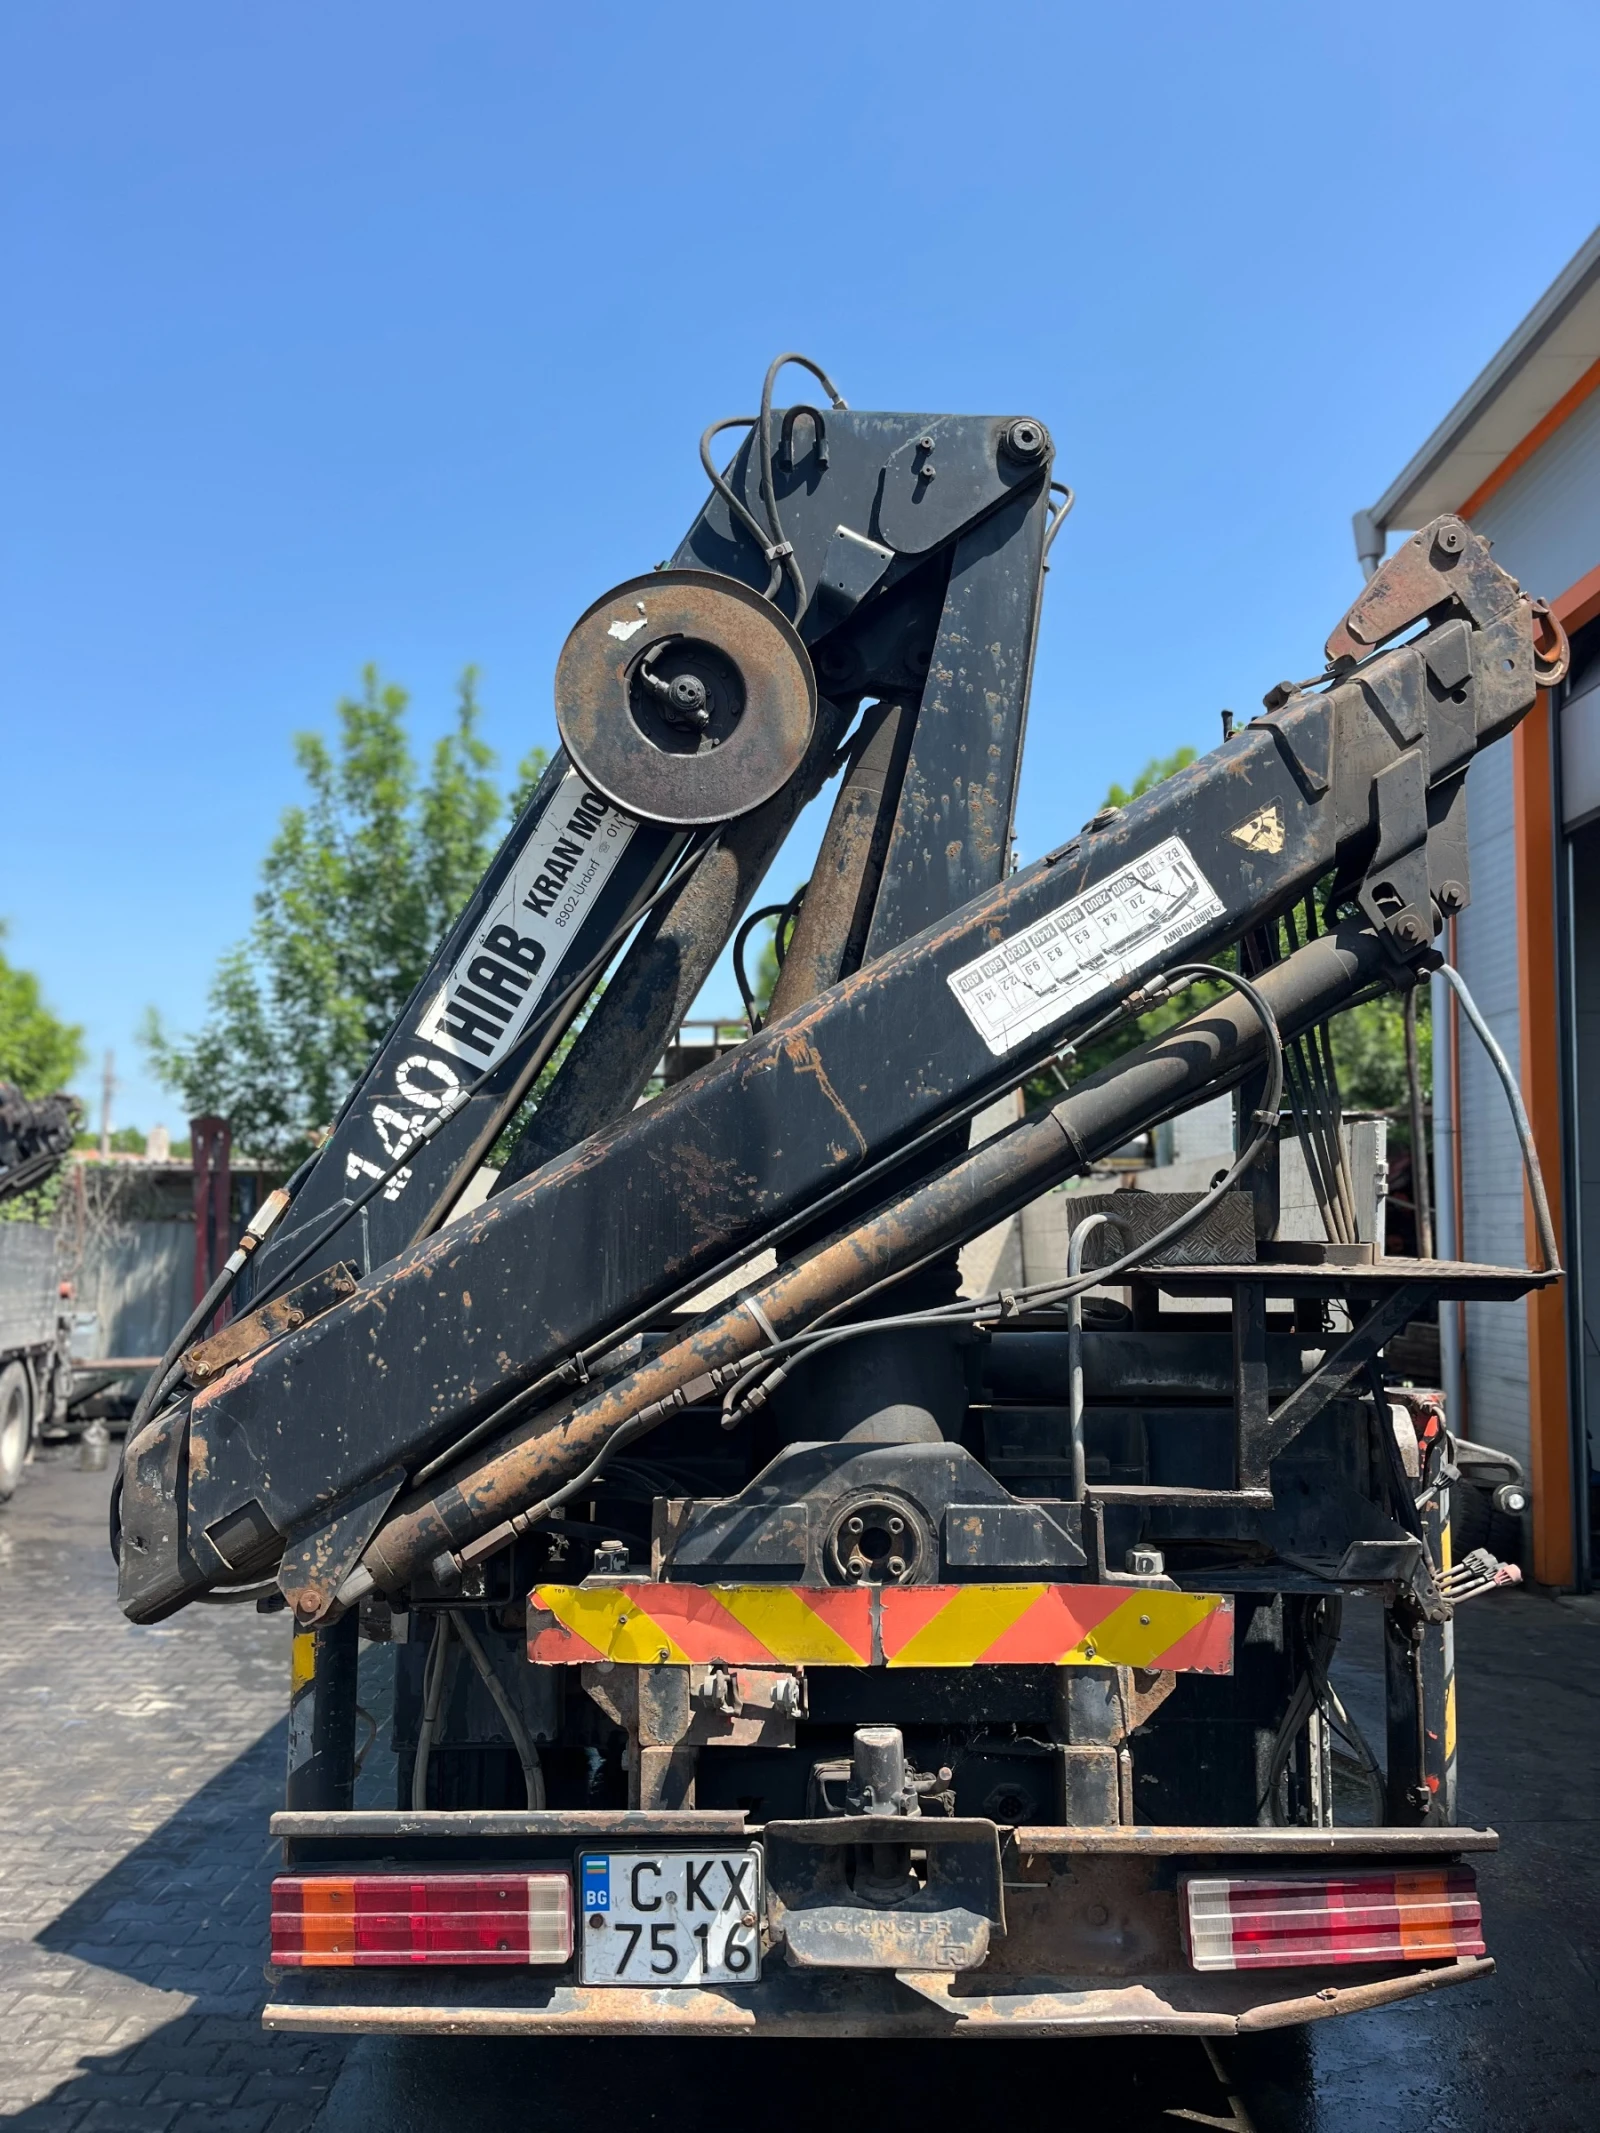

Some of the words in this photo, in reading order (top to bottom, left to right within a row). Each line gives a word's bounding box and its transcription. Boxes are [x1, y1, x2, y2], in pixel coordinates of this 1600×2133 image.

[1164, 847, 1181, 862] B2
[520, 836, 586, 918] KRAN
[1138, 862, 1154, 879] kg
[1084, 891, 1110, 913] 2800
[1128, 894, 1147, 910] 2.0
[1058, 908, 1083, 929] 1940
[1101, 911, 1120, 927] 4.4
[1031, 925, 1056, 946] 1440
[1073, 928, 1092, 945] 6.3
[1005, 941, 1030, 962] 1030
[1046, 946, 1064, 963] 8.3
[983, 958, 1004, 976] 660
[1024, 960, 1042, 977] 9.9
[436, 924, 546, 1057] HIAB
[959, 972, 981, 991] 490
[1000, 973, 1021, 992] 12.2
[977, 987, 997, 1005] 14.1
[345, 1055, 460, 1202] 140
[631, 1861, 663, 1912] C
[686, 1860, 751, 1911] KX
[586, 1890, 608, 1906] BG
[615, 1923, 751, 1975] 7516
